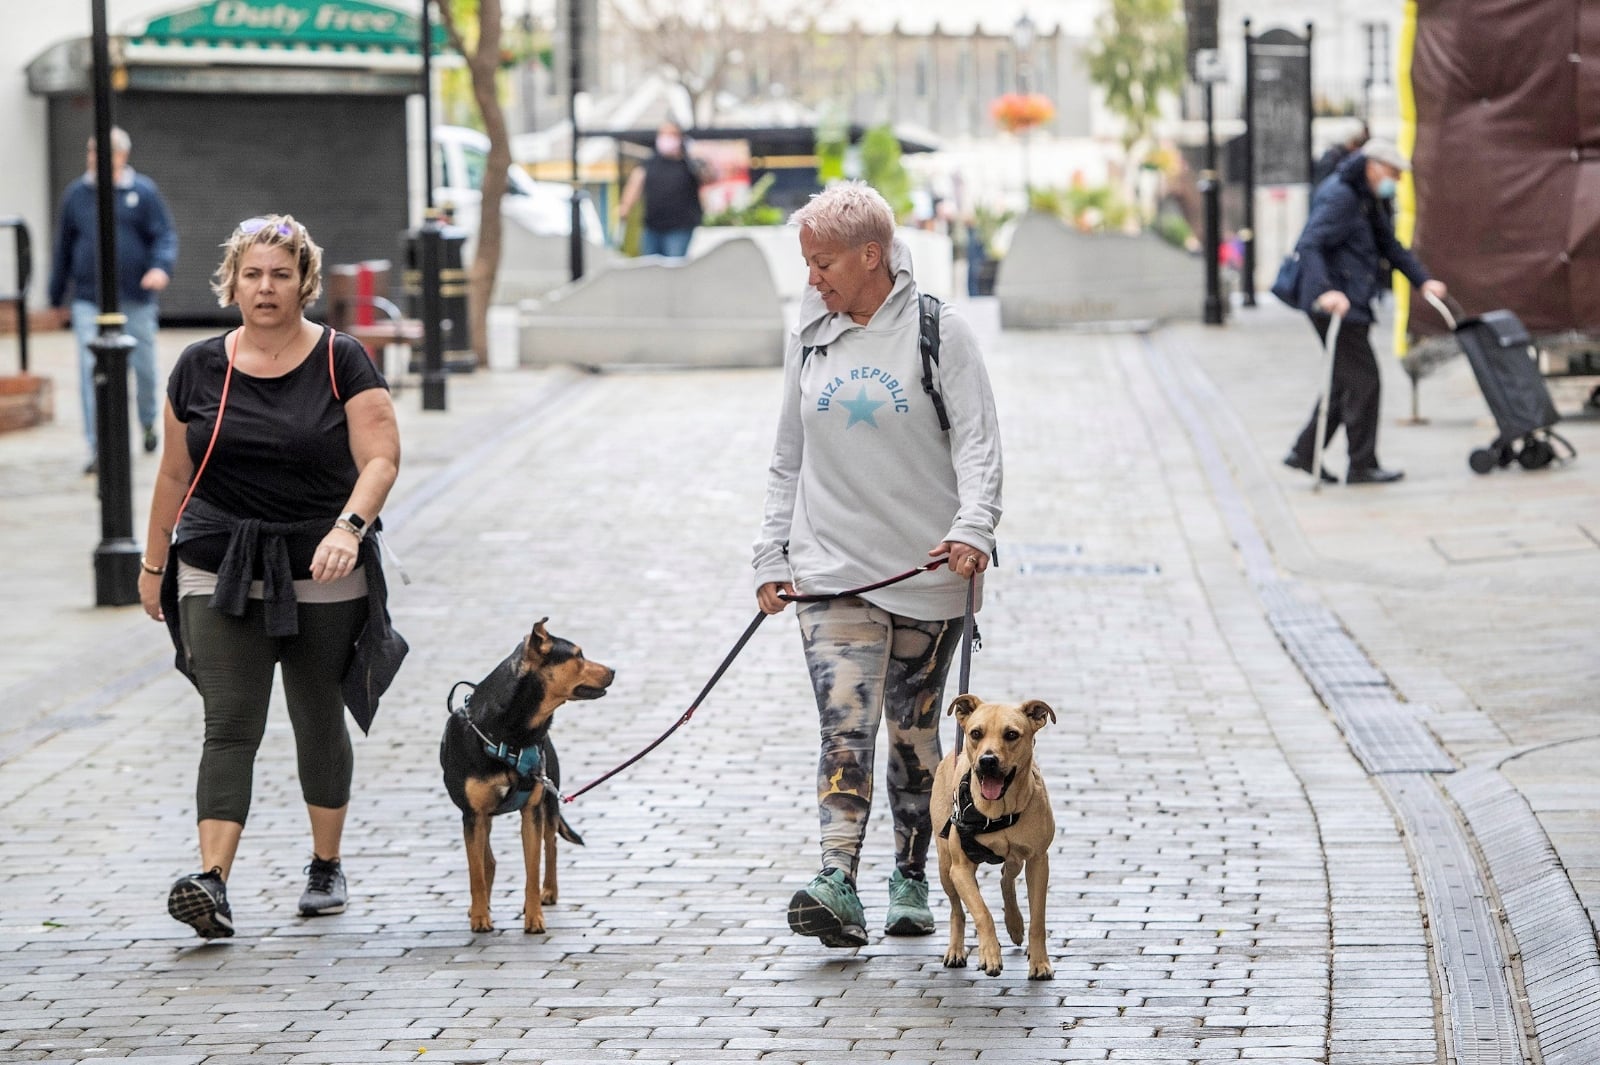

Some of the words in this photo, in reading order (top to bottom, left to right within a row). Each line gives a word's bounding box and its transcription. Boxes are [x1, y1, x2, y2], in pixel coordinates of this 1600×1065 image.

[213, 0, 307, 35] Duty
[314, 3, 397, 32] Free
[817, 376, 844, 412] IBIZA
[850, 366, 909, 413] REPUBLIC
